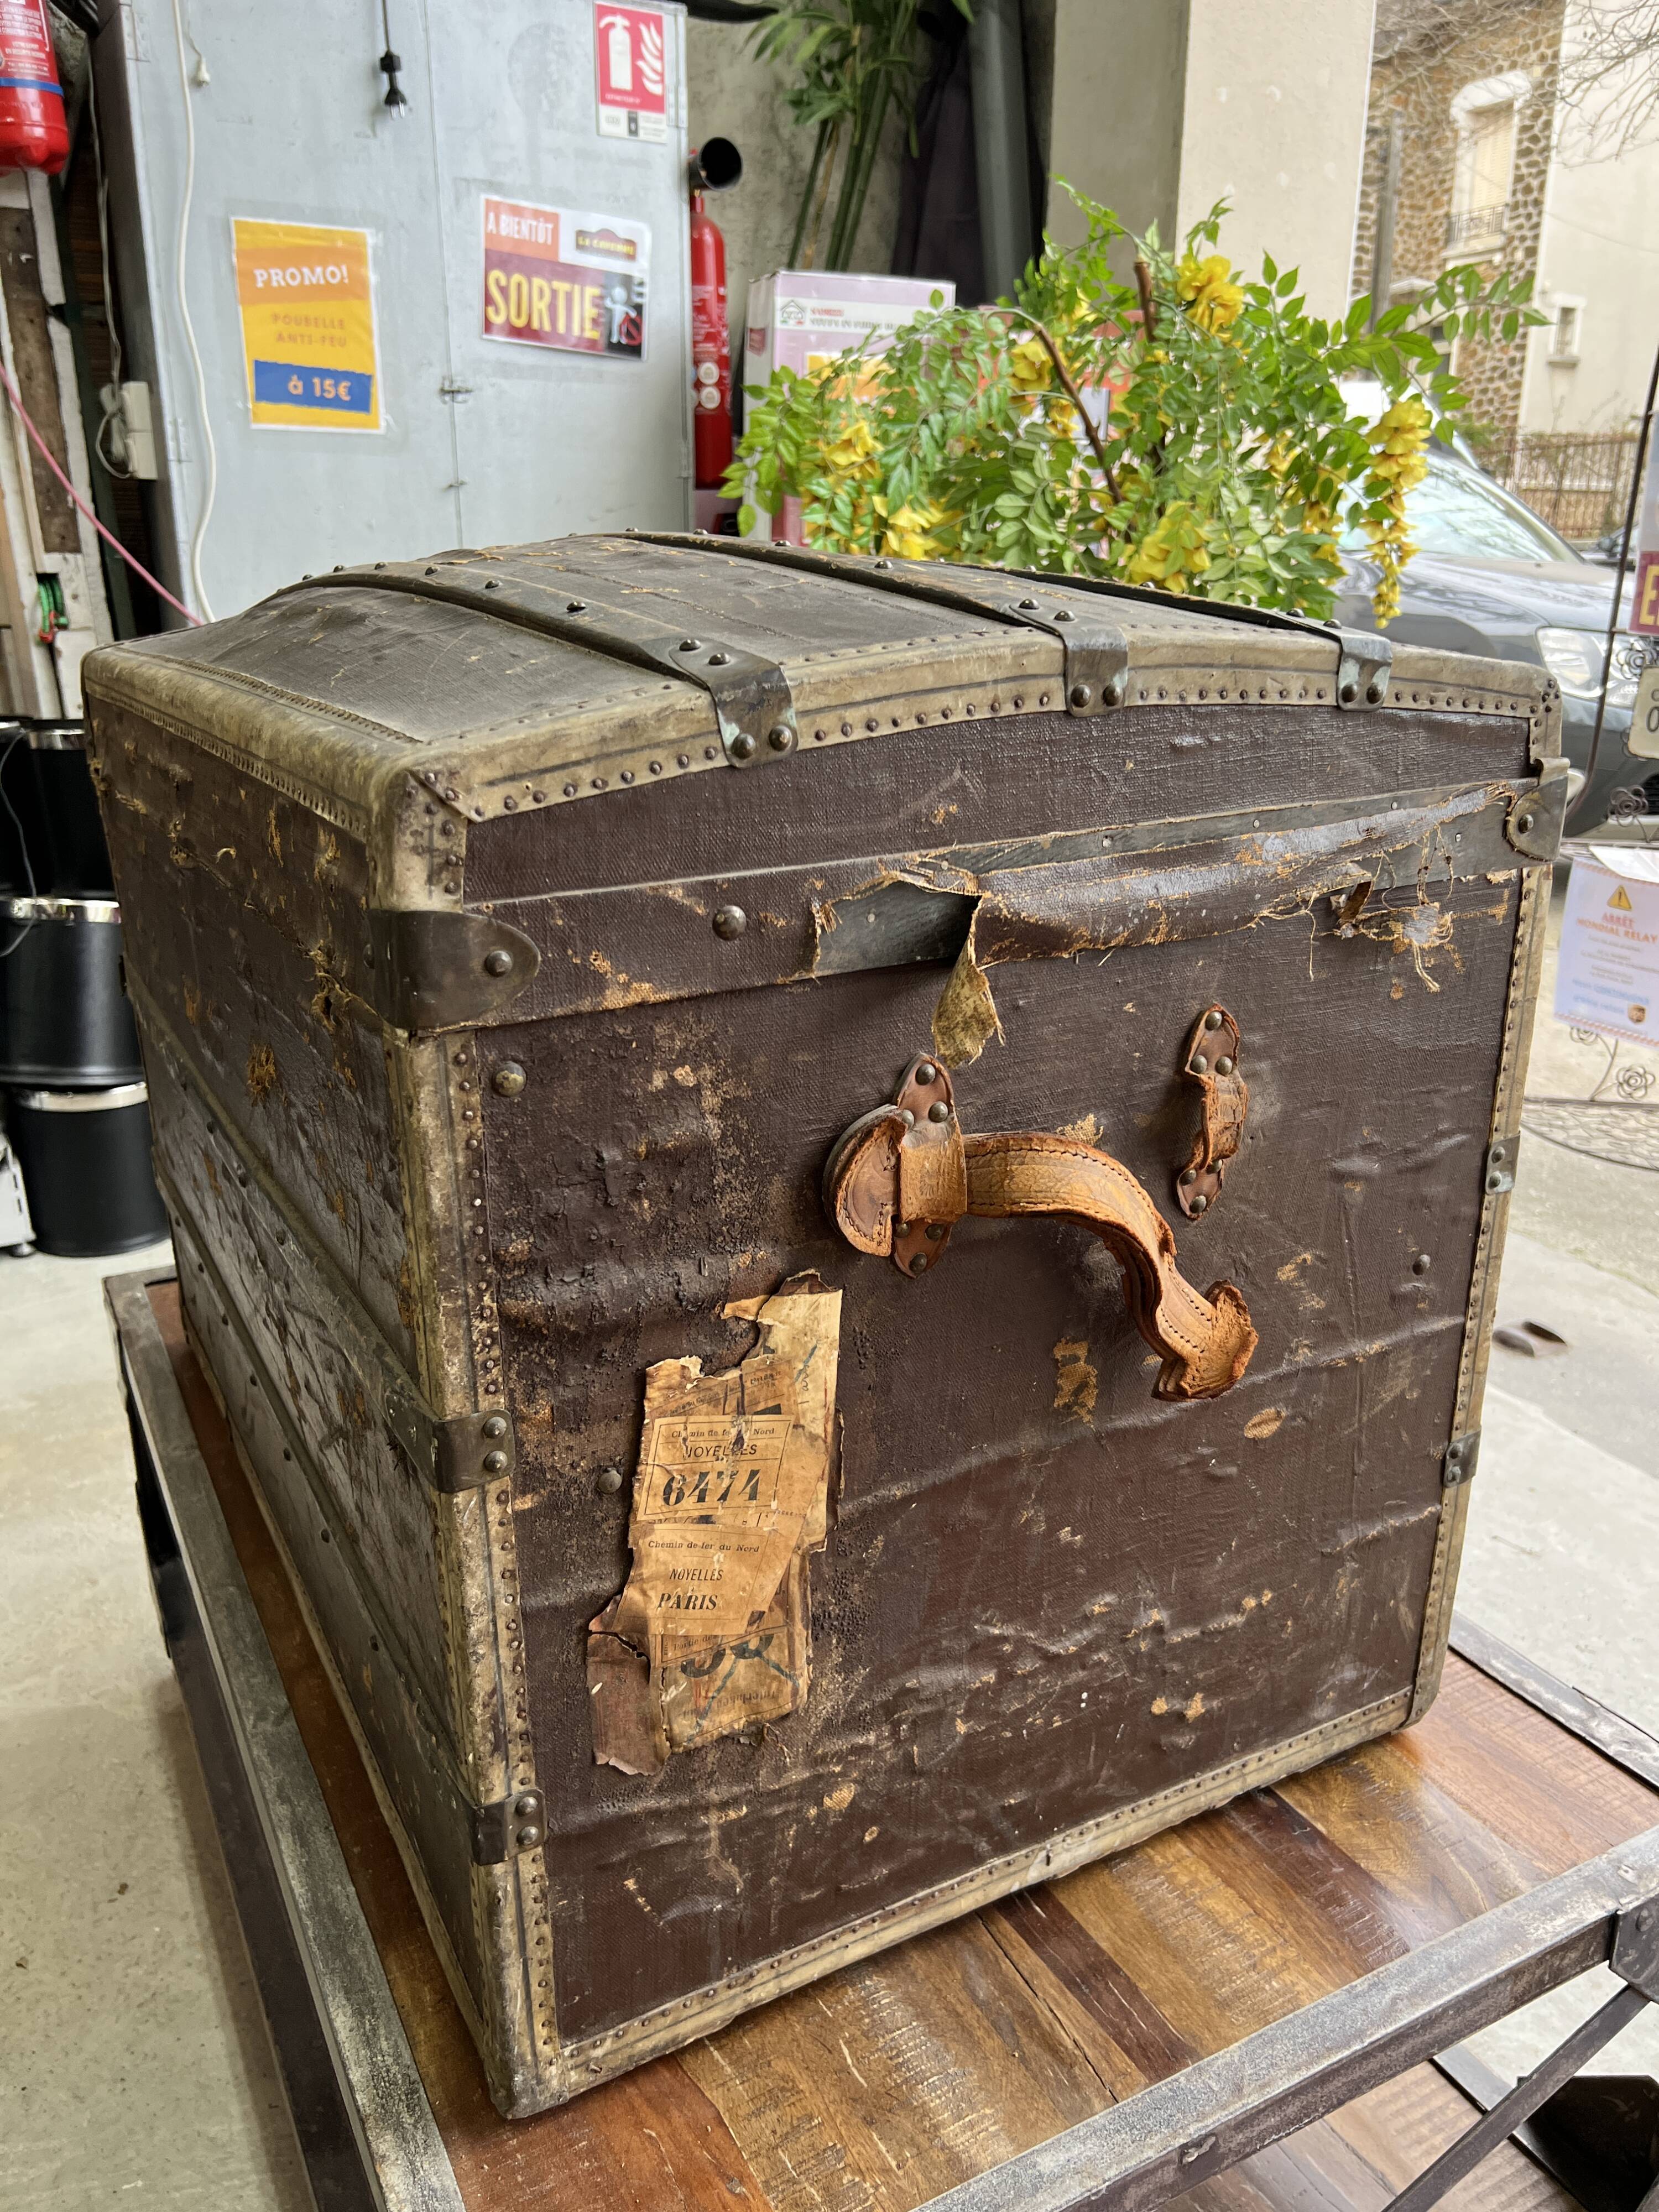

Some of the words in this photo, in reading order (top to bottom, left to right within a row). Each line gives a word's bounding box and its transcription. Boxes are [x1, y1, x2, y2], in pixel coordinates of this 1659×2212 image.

[253, 264, 349, 289] PROMO!
[486, 269, 602, 340] SORTIE
[312, 377, 352, 401] 15€
[1624, 930, 1658, 944] RELAY
[648, 1540, 683, 1548] Chemin
[701, 1541, 714, 1550] fer
[736, 1544, 760, 1552] Nord
[669, 1568, 724, 1581] NOYELLES
[657, 1592, 718, 1610] PARIS
